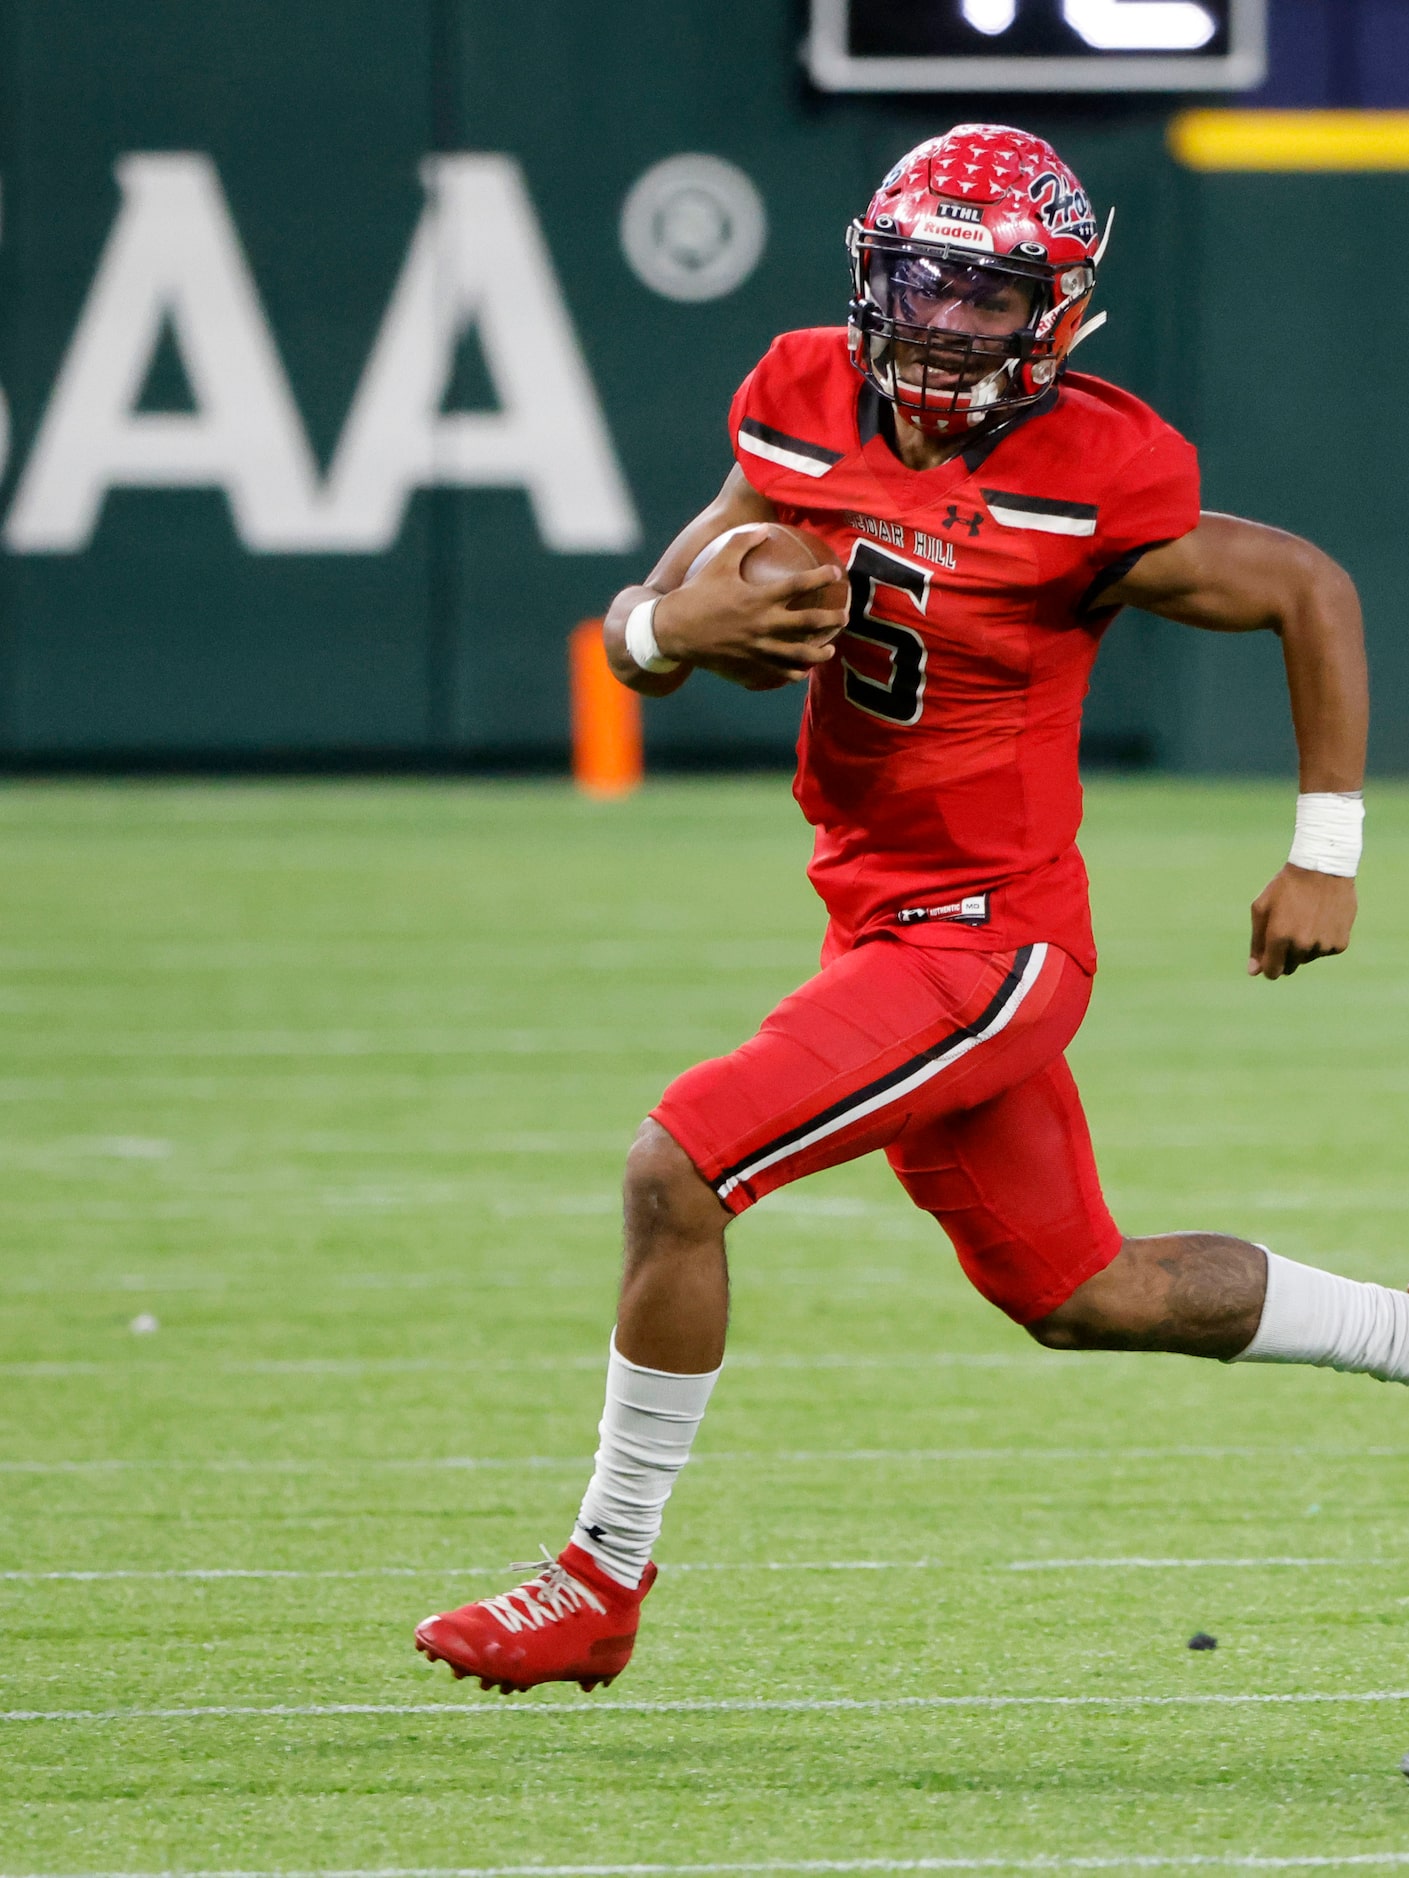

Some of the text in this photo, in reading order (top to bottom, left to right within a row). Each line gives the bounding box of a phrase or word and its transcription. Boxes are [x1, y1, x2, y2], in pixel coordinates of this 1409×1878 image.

[924, 221, 984, 242] Riddell
[939, 203, 981, 222] TTHL
[0, 150, 645, 557] AA
[912, 530, 957, 571] HILL
[840, 536, 935, 727] 5
